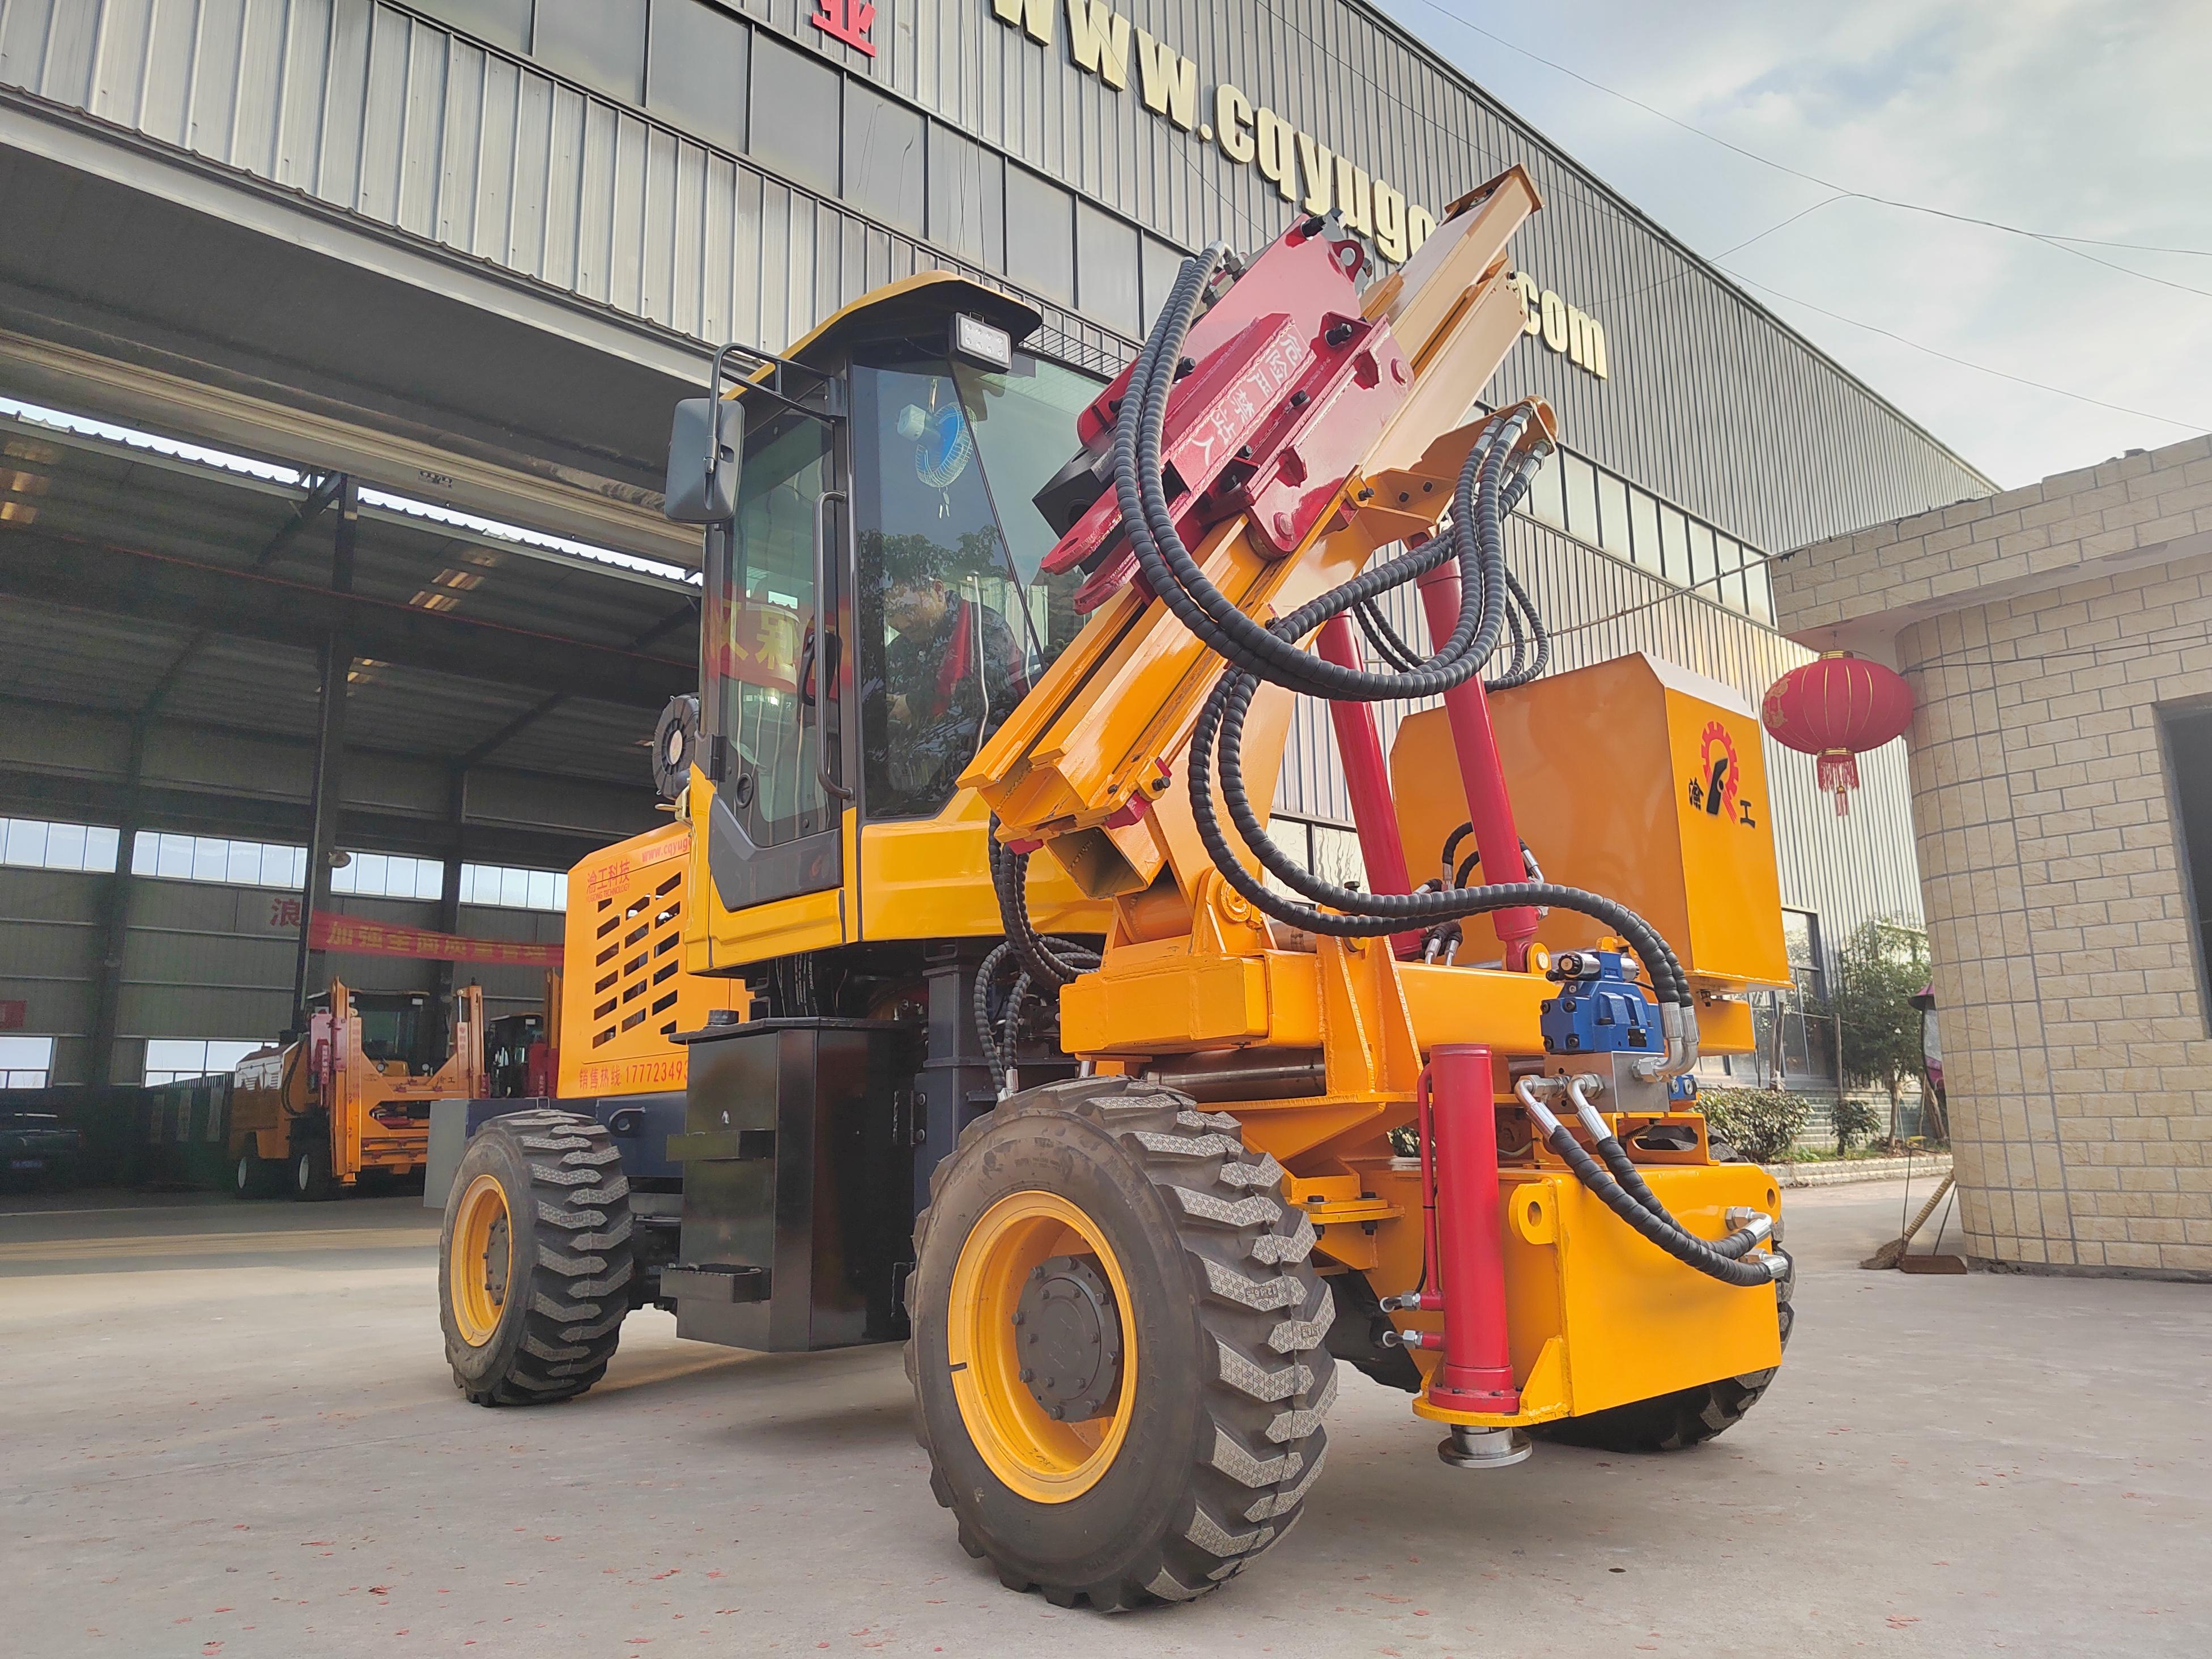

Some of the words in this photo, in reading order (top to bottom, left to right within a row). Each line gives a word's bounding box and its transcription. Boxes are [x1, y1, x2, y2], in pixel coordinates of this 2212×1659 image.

[1192, 333, 1304, 466] 危险严禁站人
[603, 883, 630, 897] TECHNOLOGY
[269, 897, 301, 928] 浪
